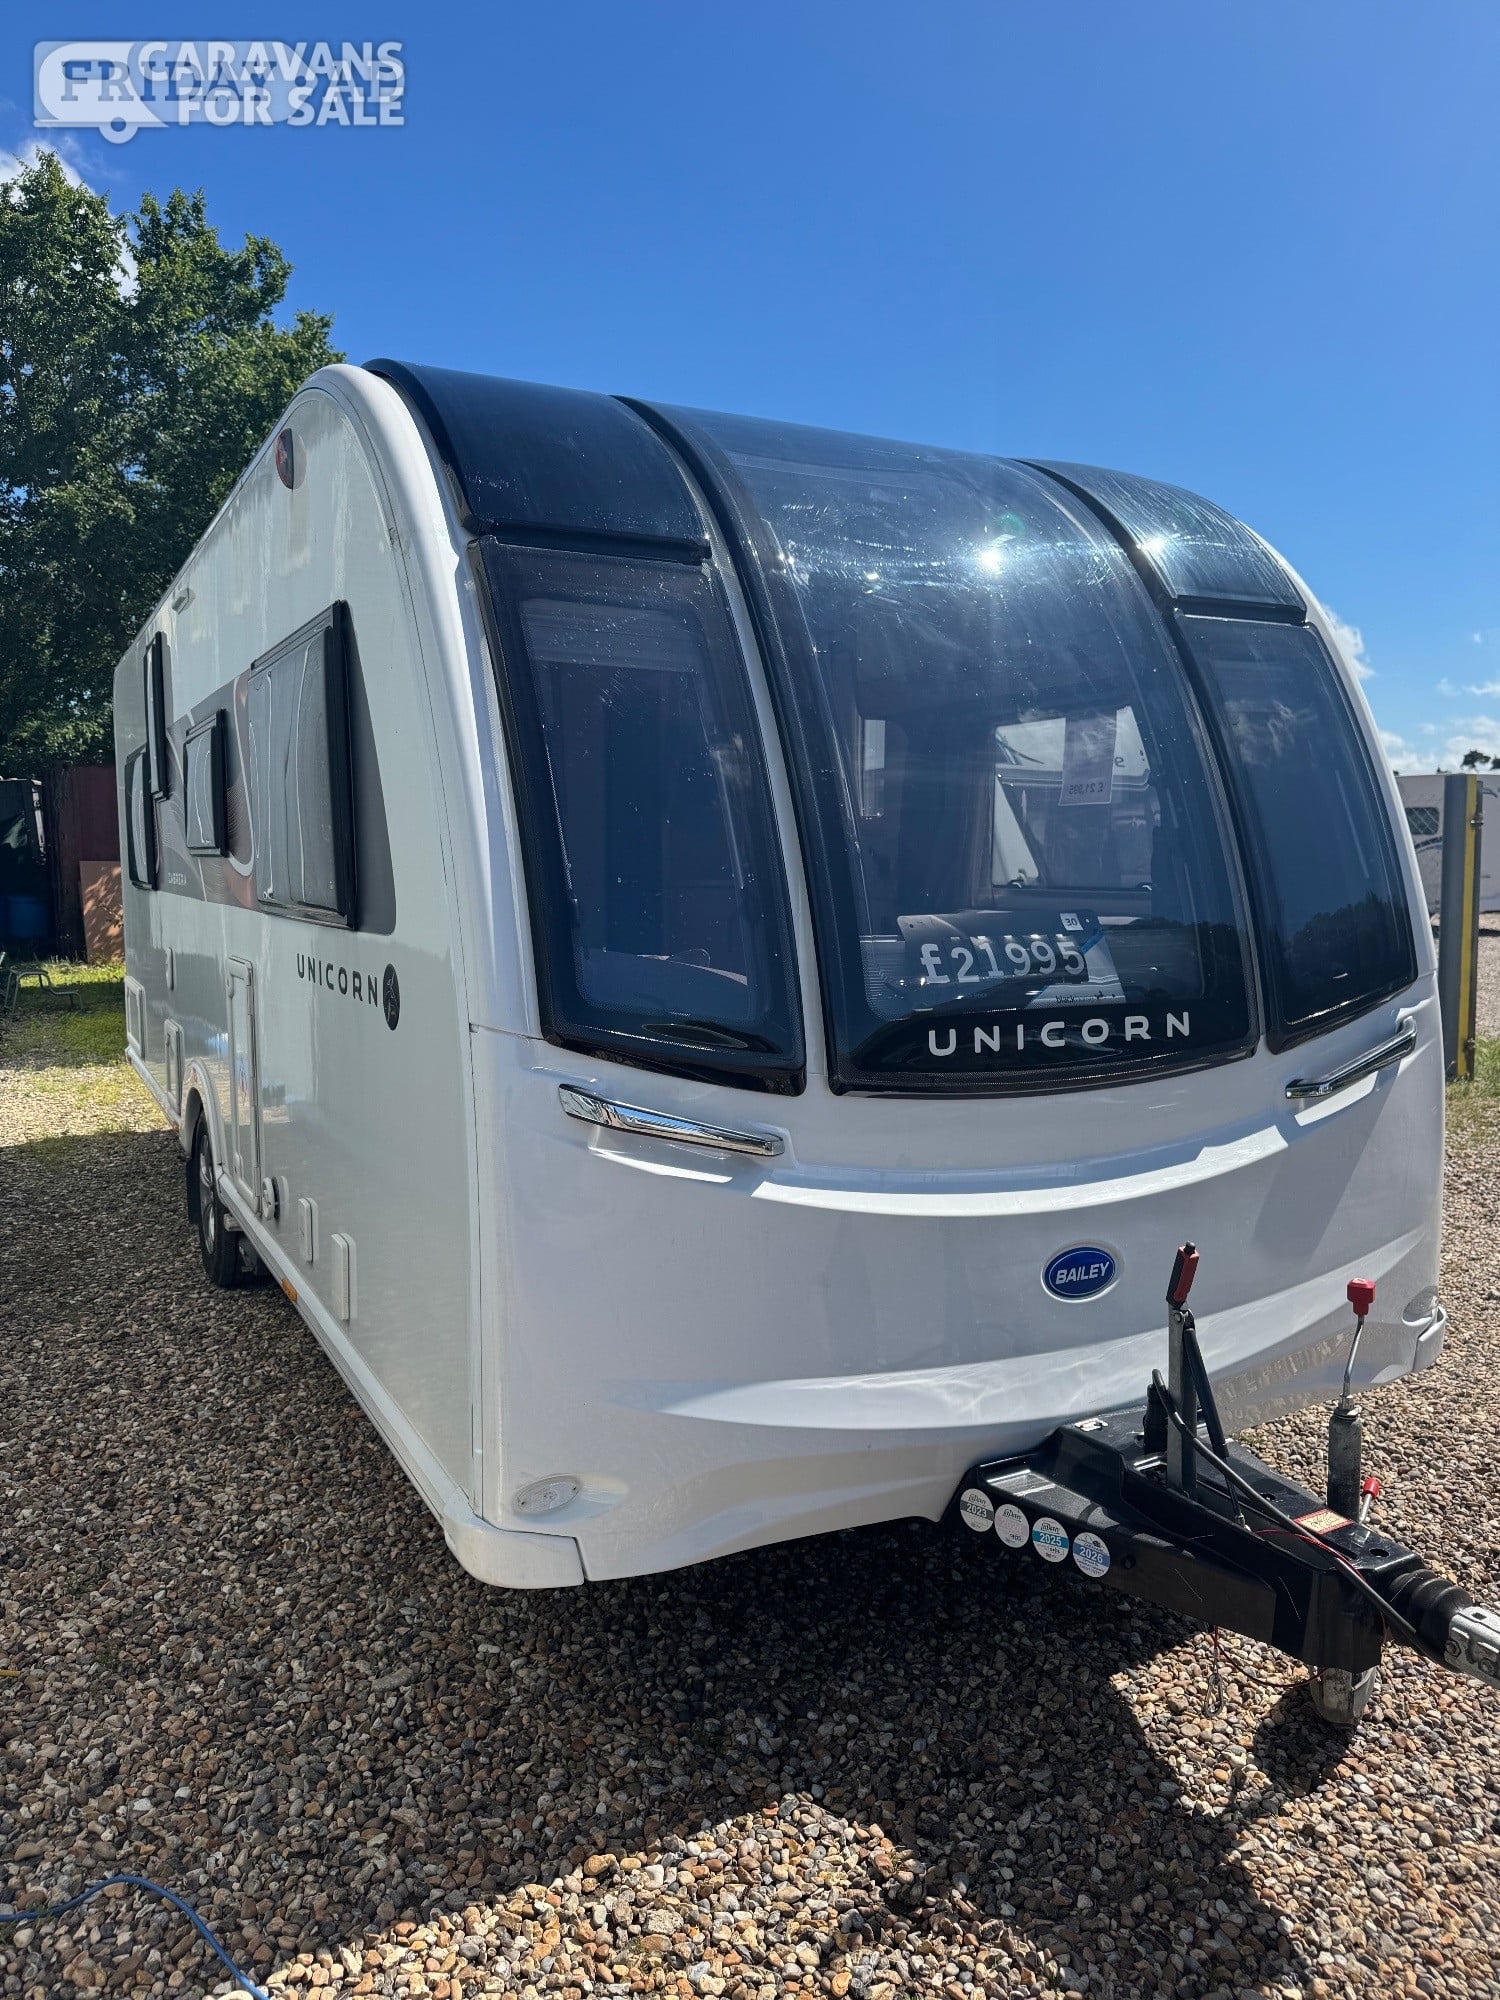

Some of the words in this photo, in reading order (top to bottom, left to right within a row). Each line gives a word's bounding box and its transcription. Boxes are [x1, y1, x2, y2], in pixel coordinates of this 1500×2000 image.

[919, 941, 1086, 984] £21995
[296, 952, 378, 1008] UNICORN
[928, 1010, 1190, 1057] UNICORN
[1055, 1261, 1110, 1285] BAILEY
[966, 1502, 987, 1518] 2023
[1039, 1532, 1062, 1547] 2025
[1079, 1545, 1103, 1564] 2026
